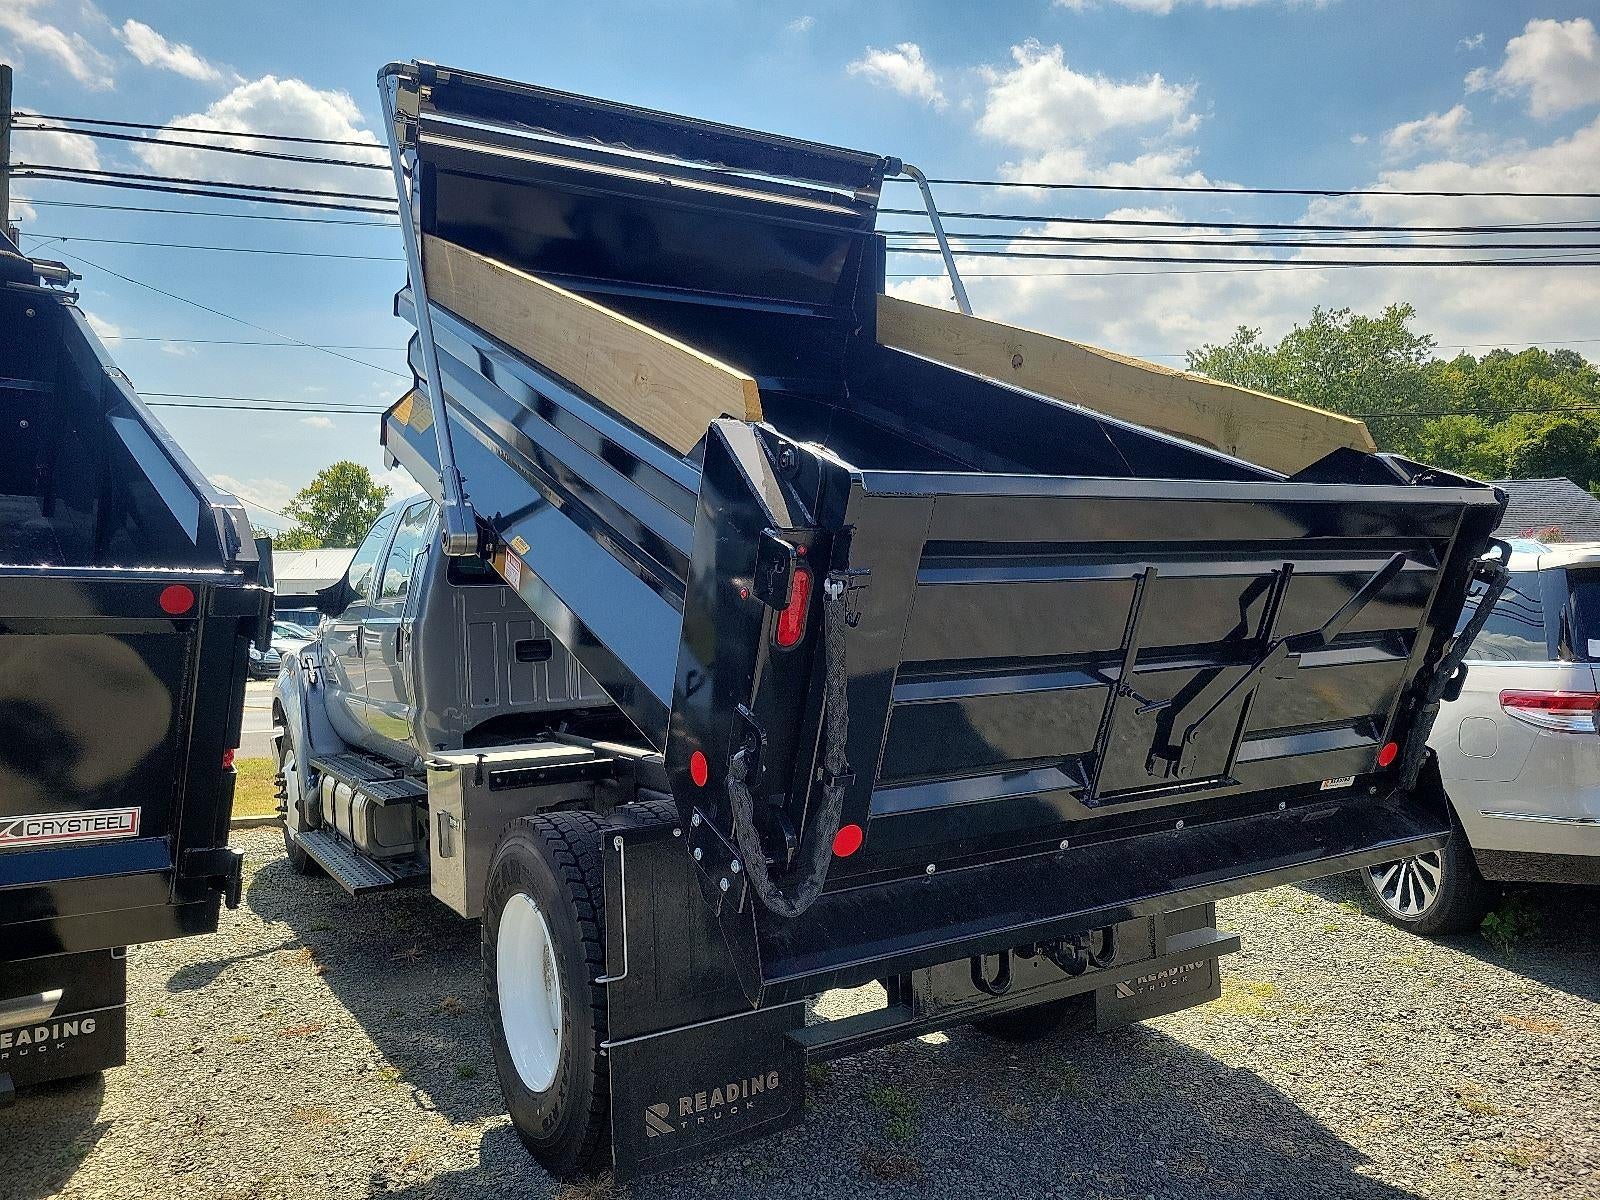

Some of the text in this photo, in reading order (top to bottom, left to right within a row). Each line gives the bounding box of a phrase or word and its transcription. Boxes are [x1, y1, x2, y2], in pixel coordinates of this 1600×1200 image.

[26, 816, 130, 836] CRYSTEEL
[1138, 976, 1188, 994] TRUCK
[679, 1071, 779, 1117] READING
[680, 1102, 755, 1129] TRUCK
